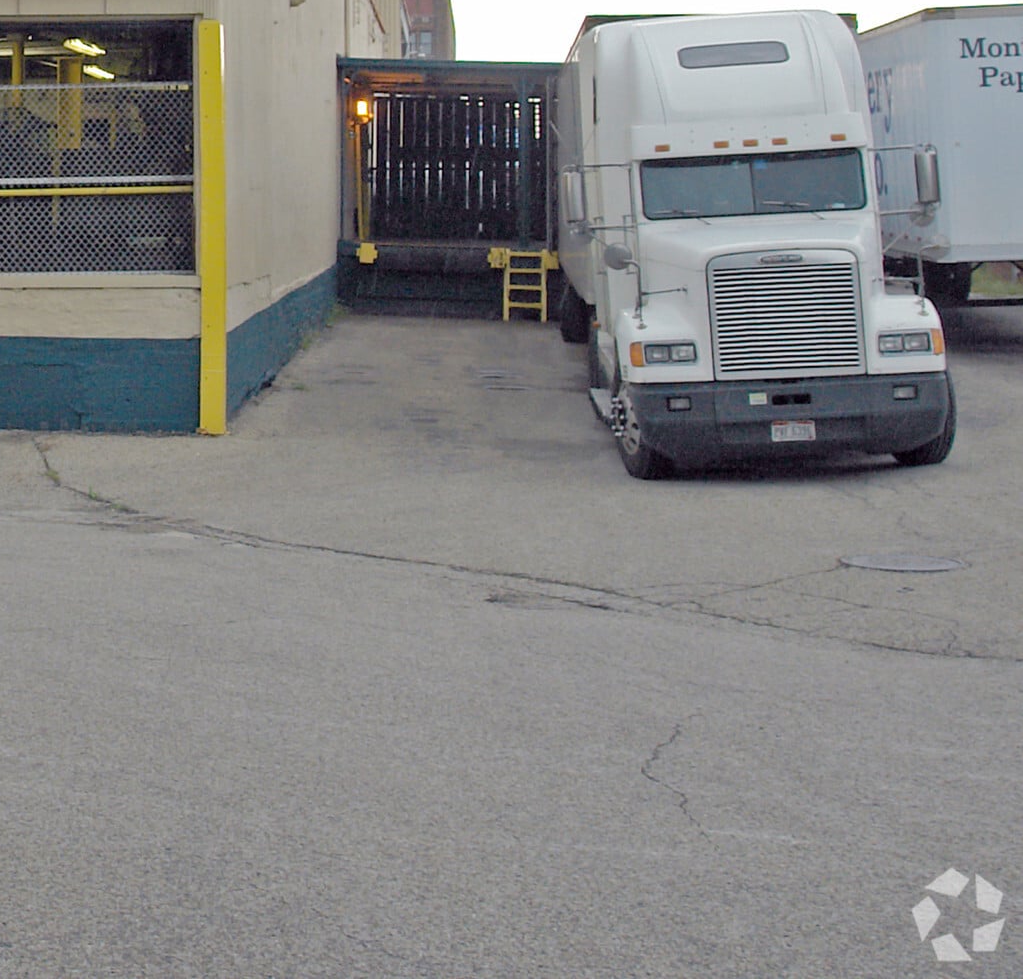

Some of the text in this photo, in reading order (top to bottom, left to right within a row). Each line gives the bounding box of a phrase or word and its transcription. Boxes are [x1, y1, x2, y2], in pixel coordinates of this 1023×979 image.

[959, 37, 1023, 58] Mon
[868, 68, 893, 134] ery
[874, 152, 888, 196] o.
